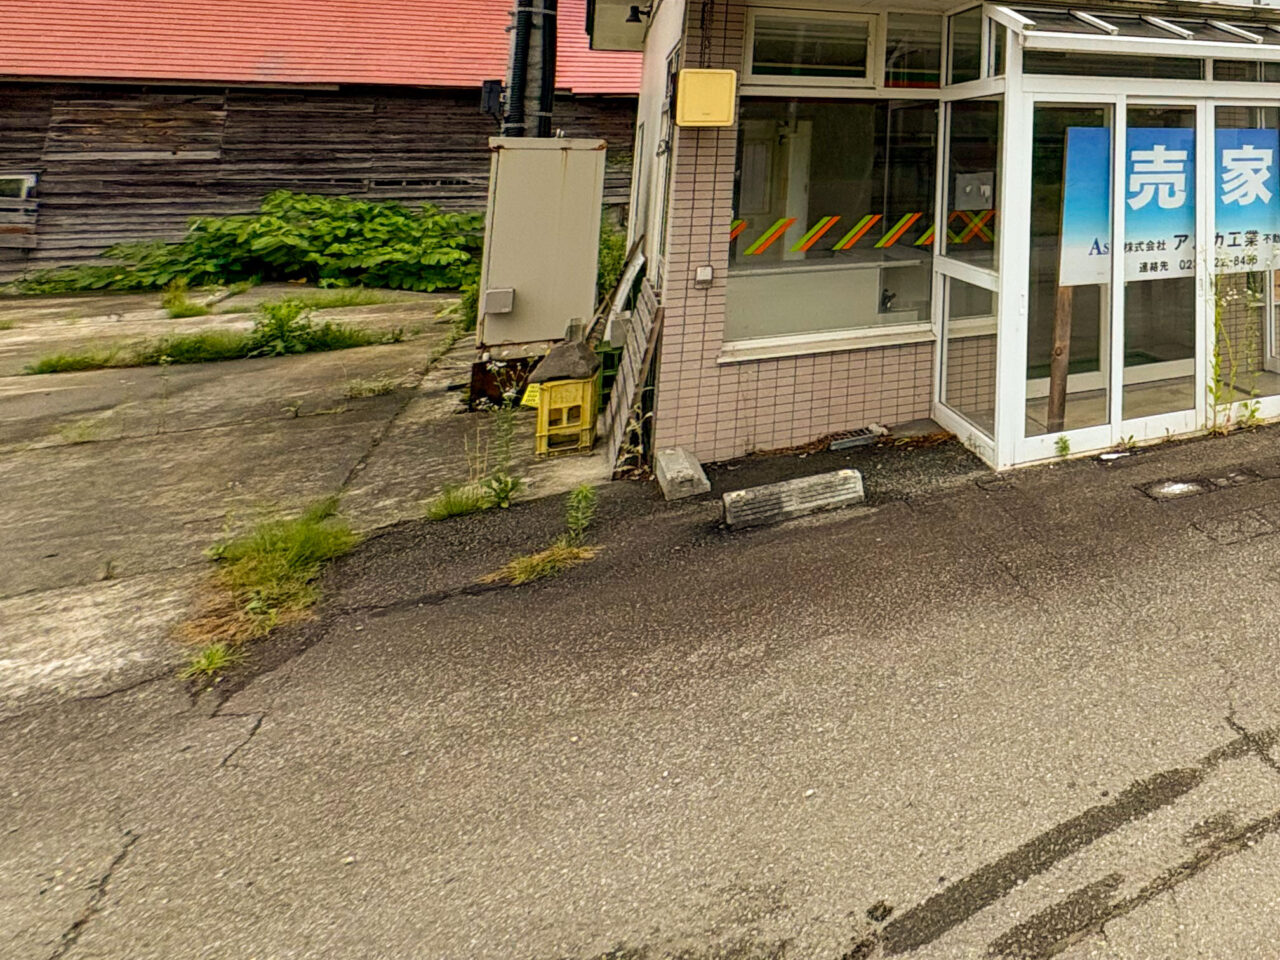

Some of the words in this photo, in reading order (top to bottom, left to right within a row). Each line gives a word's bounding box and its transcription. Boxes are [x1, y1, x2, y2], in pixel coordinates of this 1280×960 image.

[1127, 144, 1273, 210] 売家
[1124, 239, 1166, 253] 株式会社
[1173, 230, 1259, 250] アカ工業
[1138, 261, 1168, 273] 連絡先
